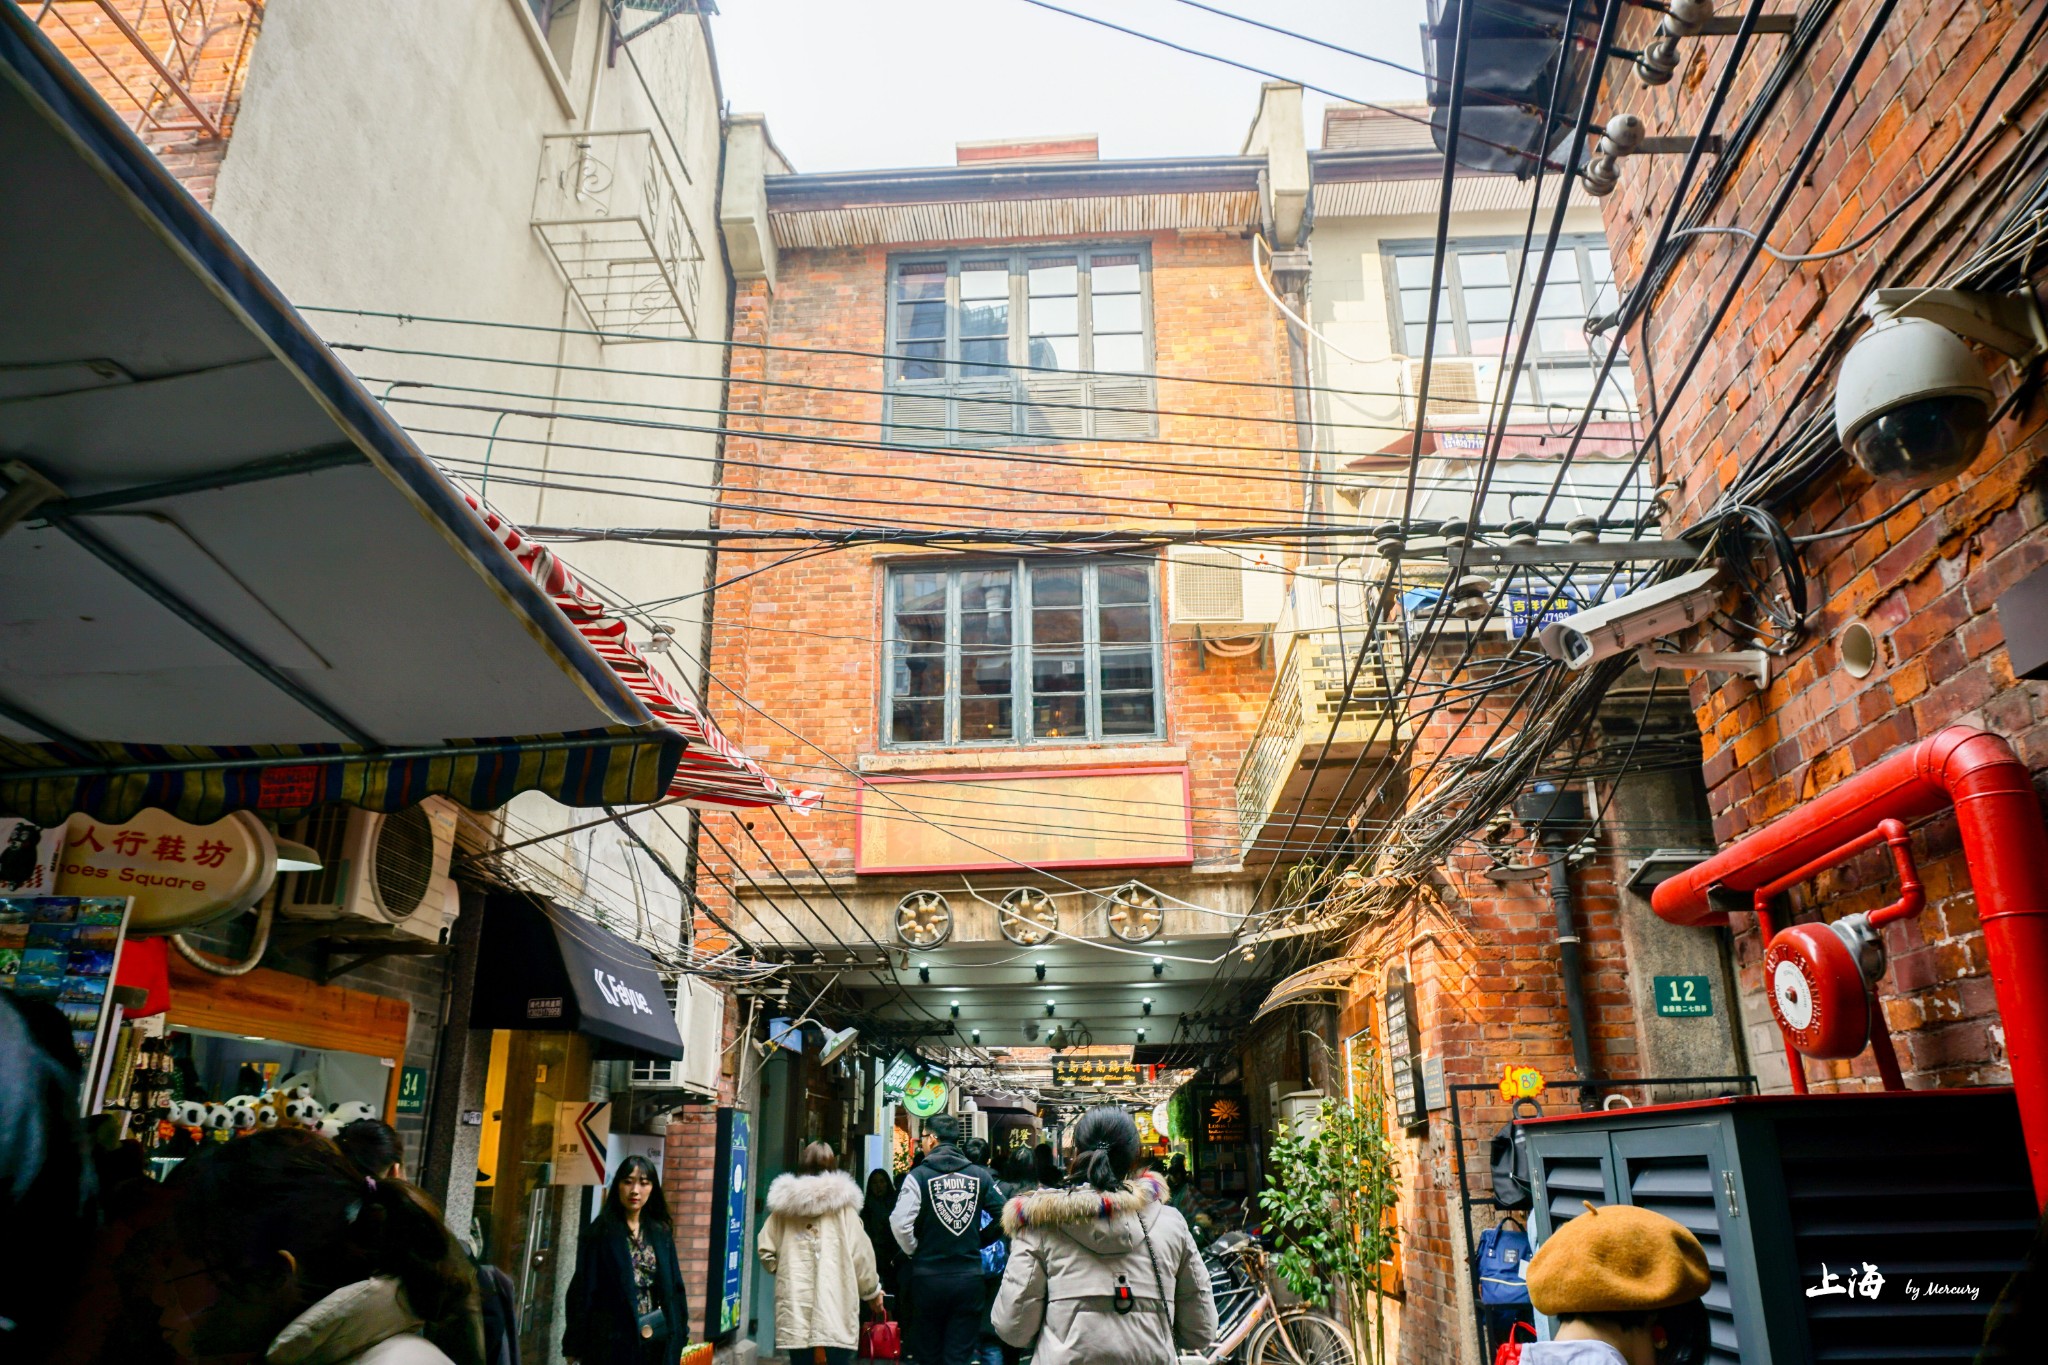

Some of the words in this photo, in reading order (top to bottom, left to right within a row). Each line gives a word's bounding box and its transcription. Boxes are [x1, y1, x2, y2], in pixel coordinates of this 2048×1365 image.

[70, 825, 232, 868] 人行鞋坊
[118, 867, 207, 892] Square
[1669, 980, 1696, 1002] 12
[403, 1072, 419, 1096] 34
